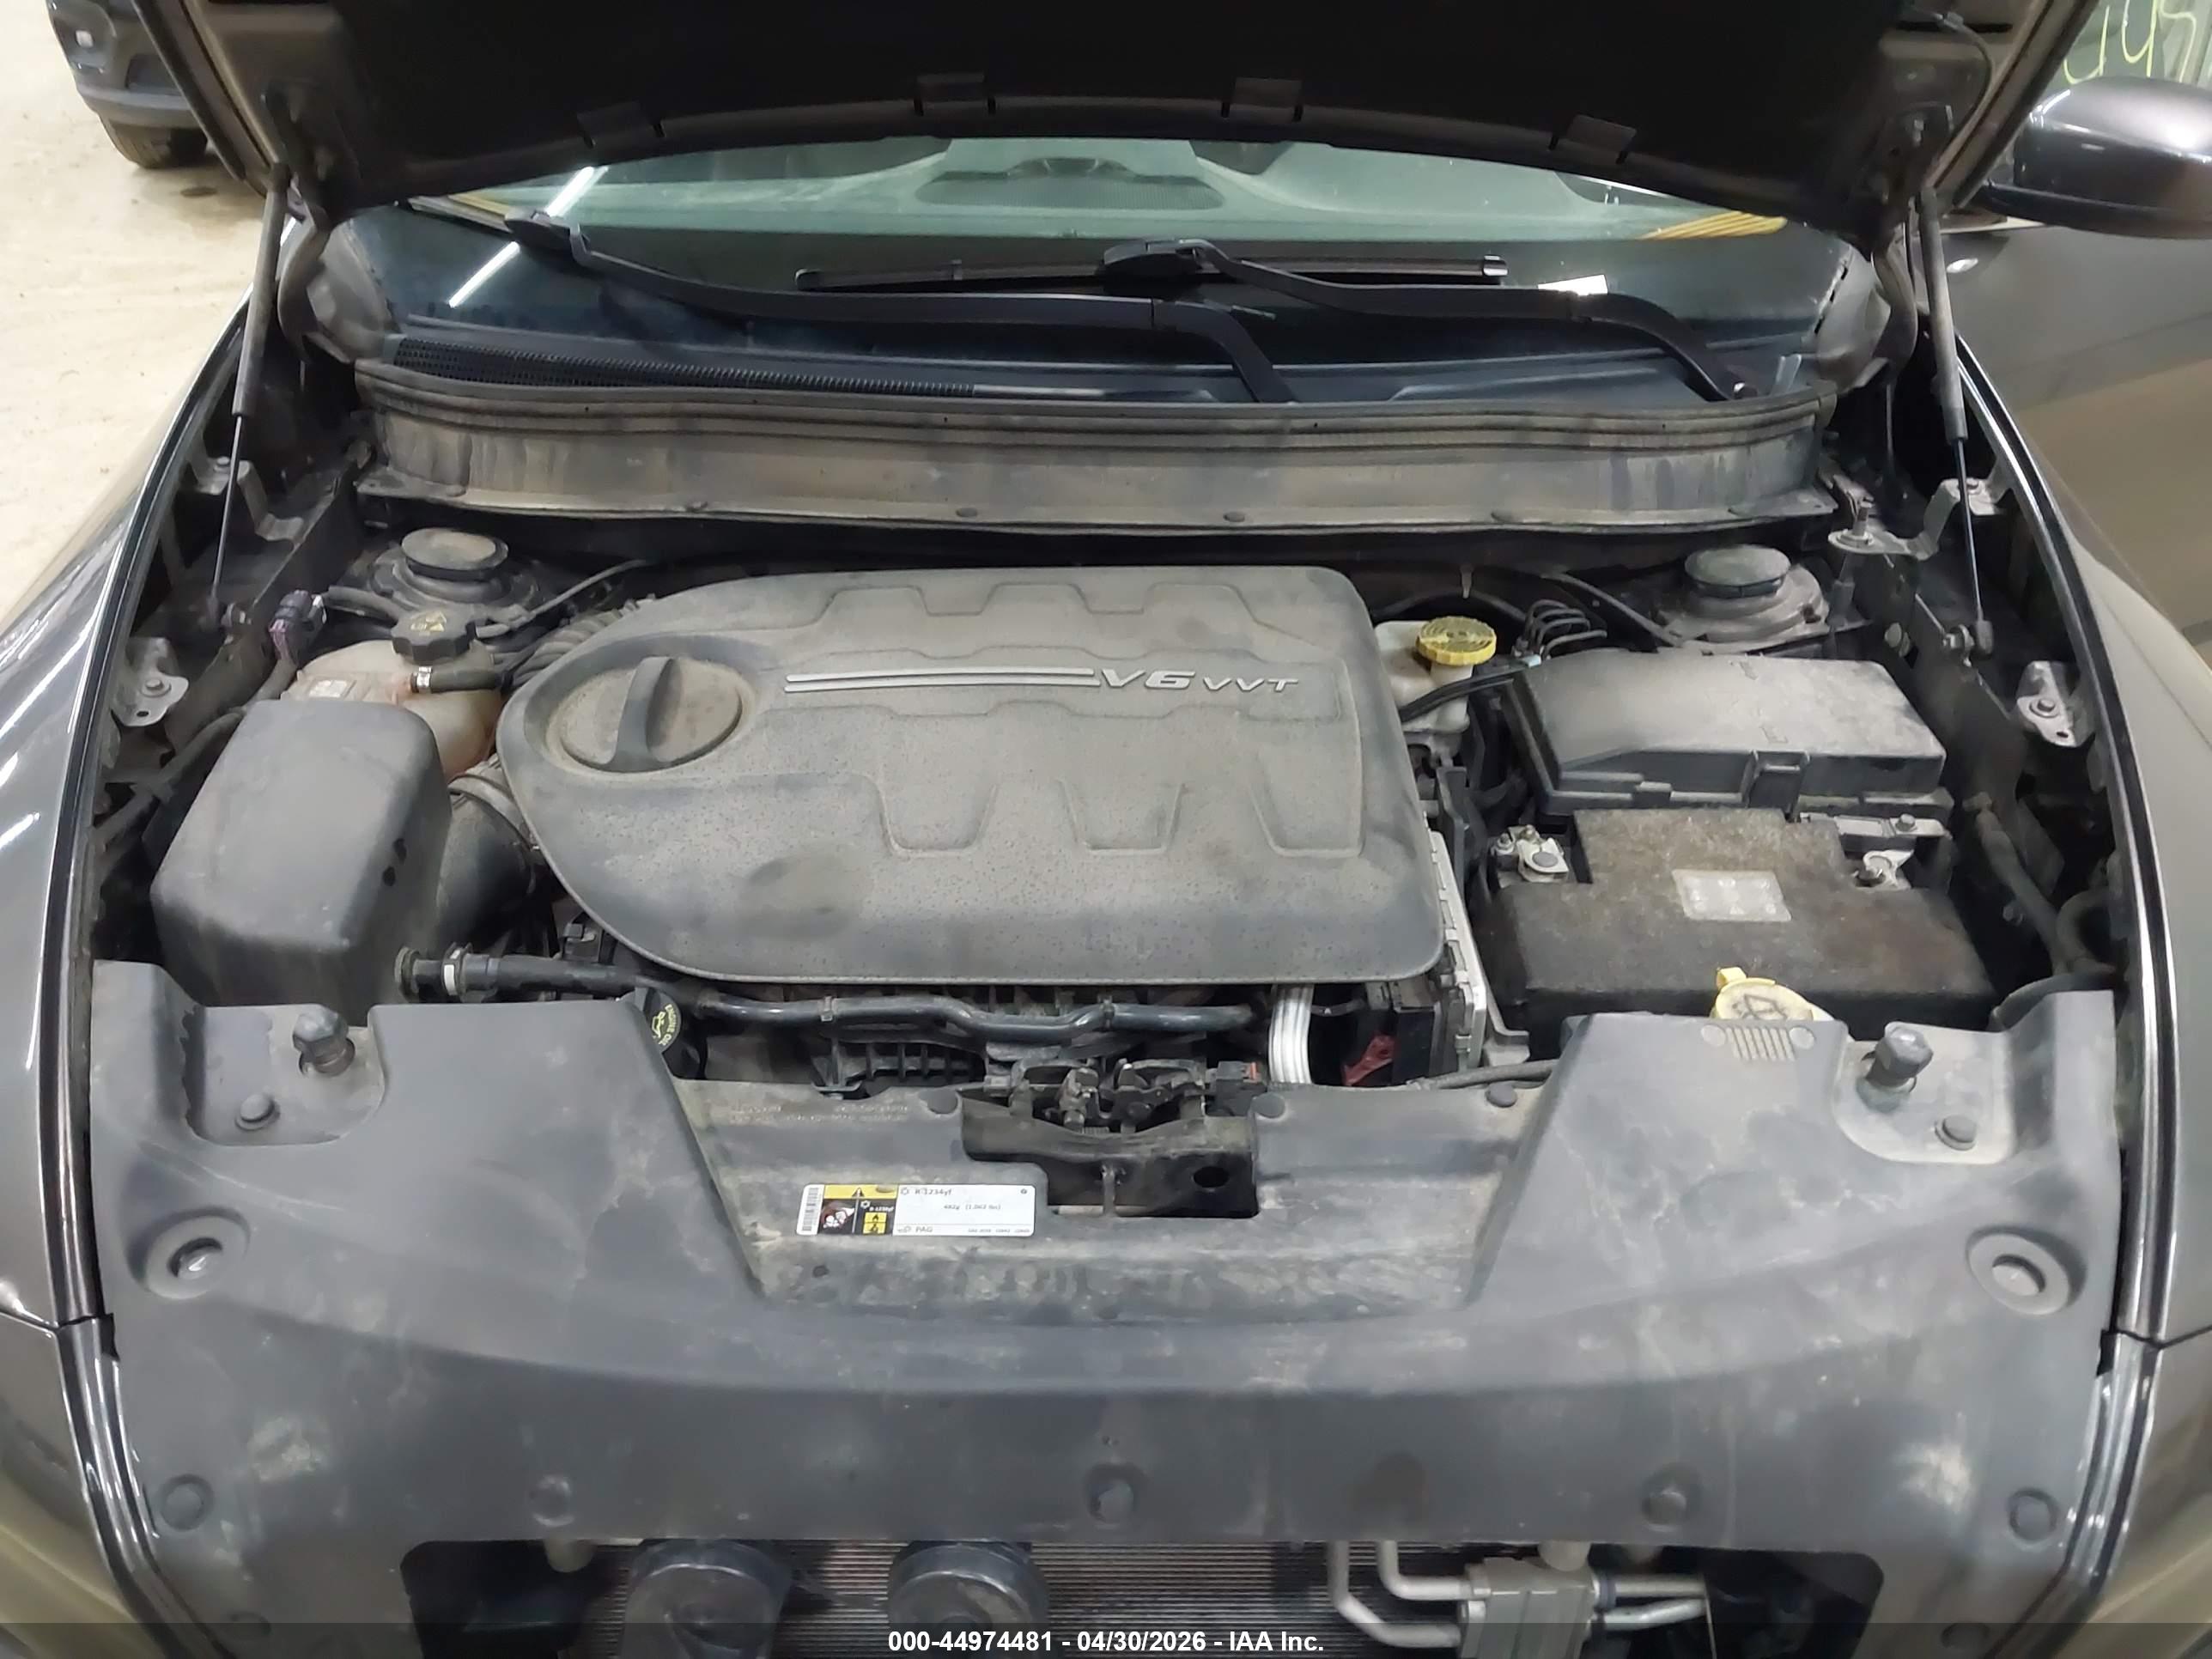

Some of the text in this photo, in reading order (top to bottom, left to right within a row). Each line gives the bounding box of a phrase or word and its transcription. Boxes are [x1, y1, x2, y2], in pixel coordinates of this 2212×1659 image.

[1102, 668, 1298, 692] V6 VVT
[658, 1004, 676, 1046] ENGINE OIL
